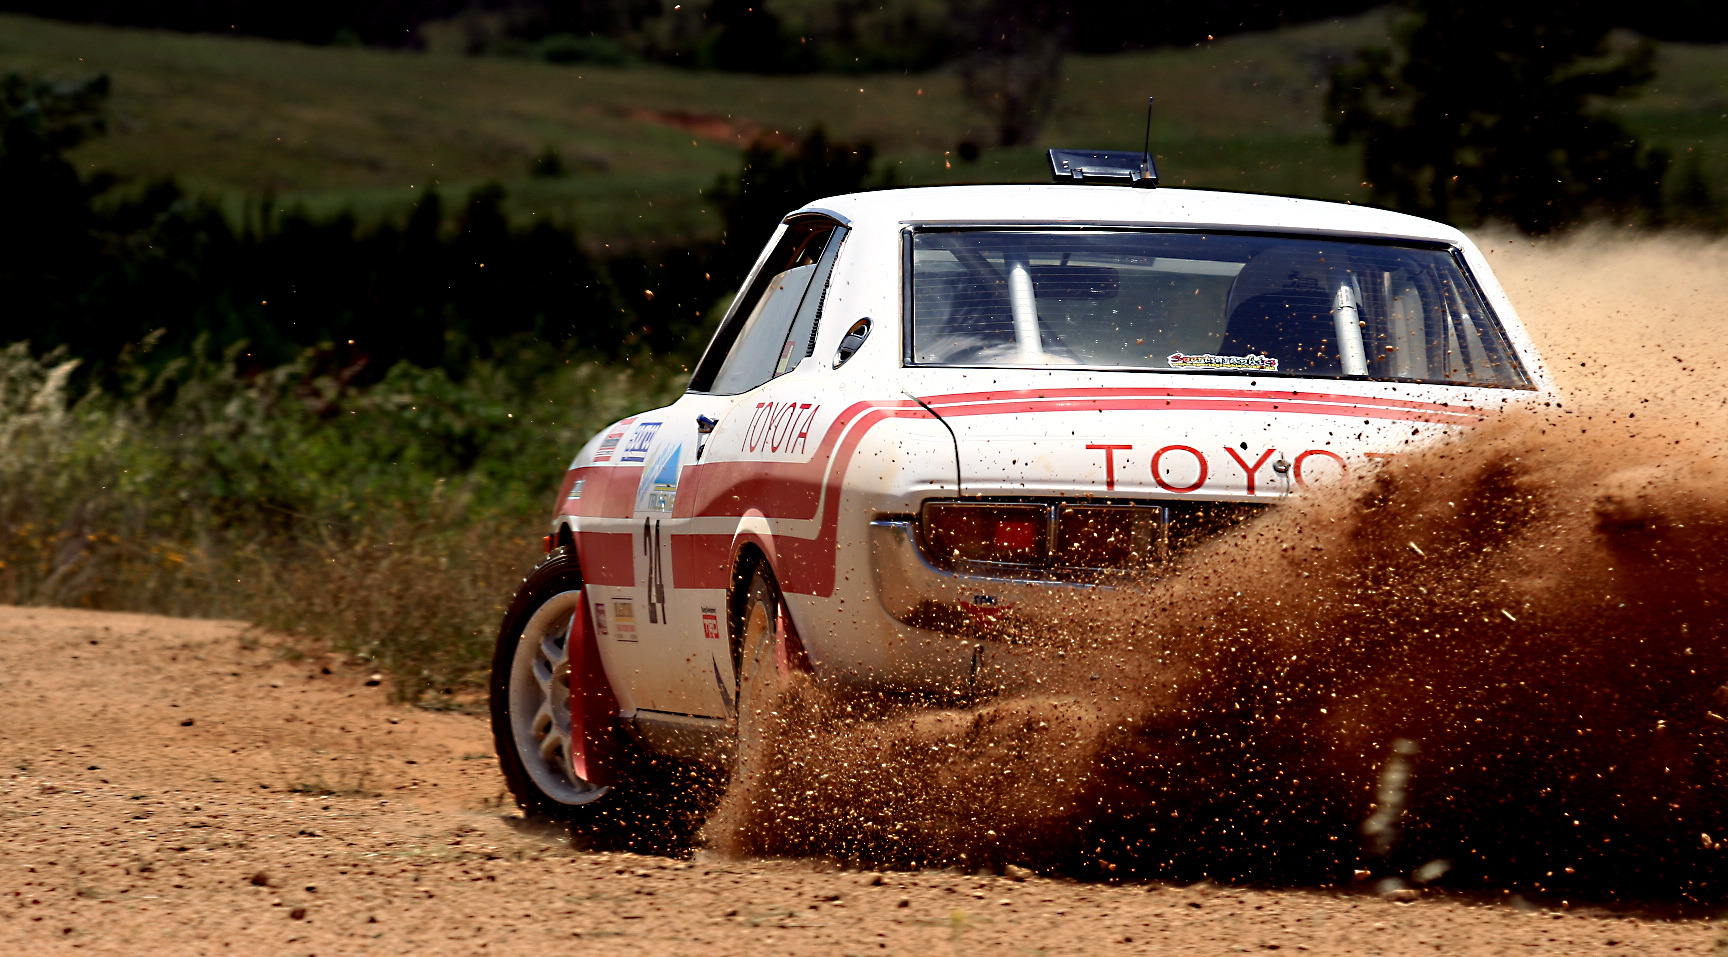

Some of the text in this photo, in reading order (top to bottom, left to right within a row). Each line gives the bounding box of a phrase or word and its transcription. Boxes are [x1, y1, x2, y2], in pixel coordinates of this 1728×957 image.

[741, 402, 820, 454] TOYOTA
[1086, 444, 1396, 496] TOYO
[644, 516, 667, 625] 24
